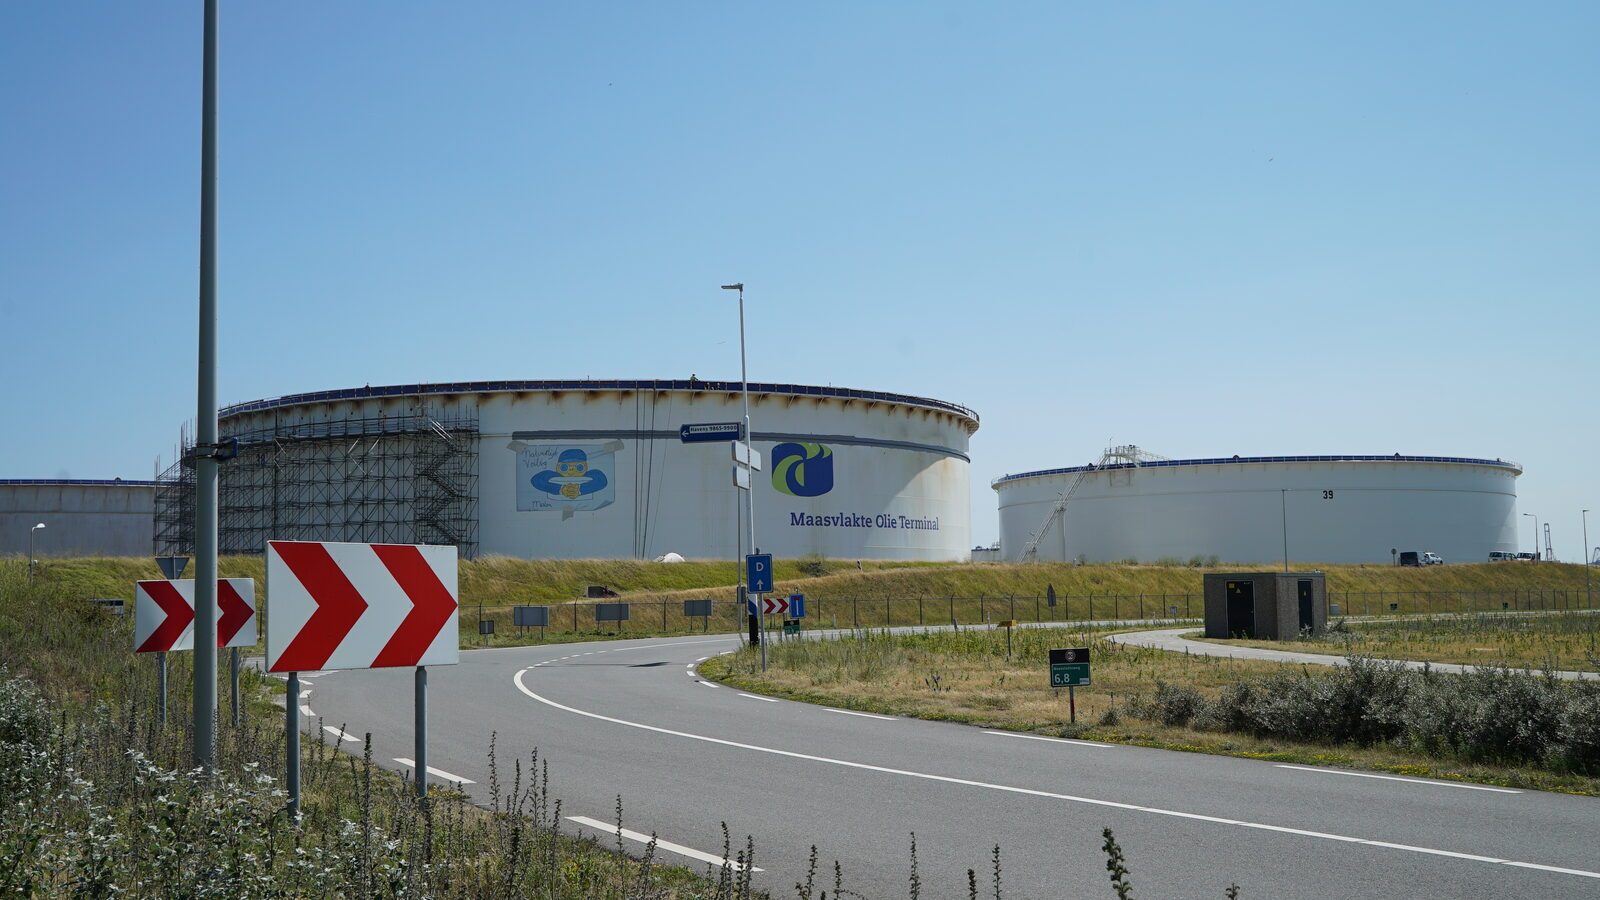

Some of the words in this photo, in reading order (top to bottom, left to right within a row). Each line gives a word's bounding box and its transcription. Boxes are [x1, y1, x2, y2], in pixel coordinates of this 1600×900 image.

[1322, 490, 1334, 500] 39
[790, 512, 872, 527] Maasvlakte
[875, 514, 897, 528] Olie
[899, 515, 939, 530] Terminal
[755, 562, 764, 572] D
[1054, 673, 1070, 684] 6,8
